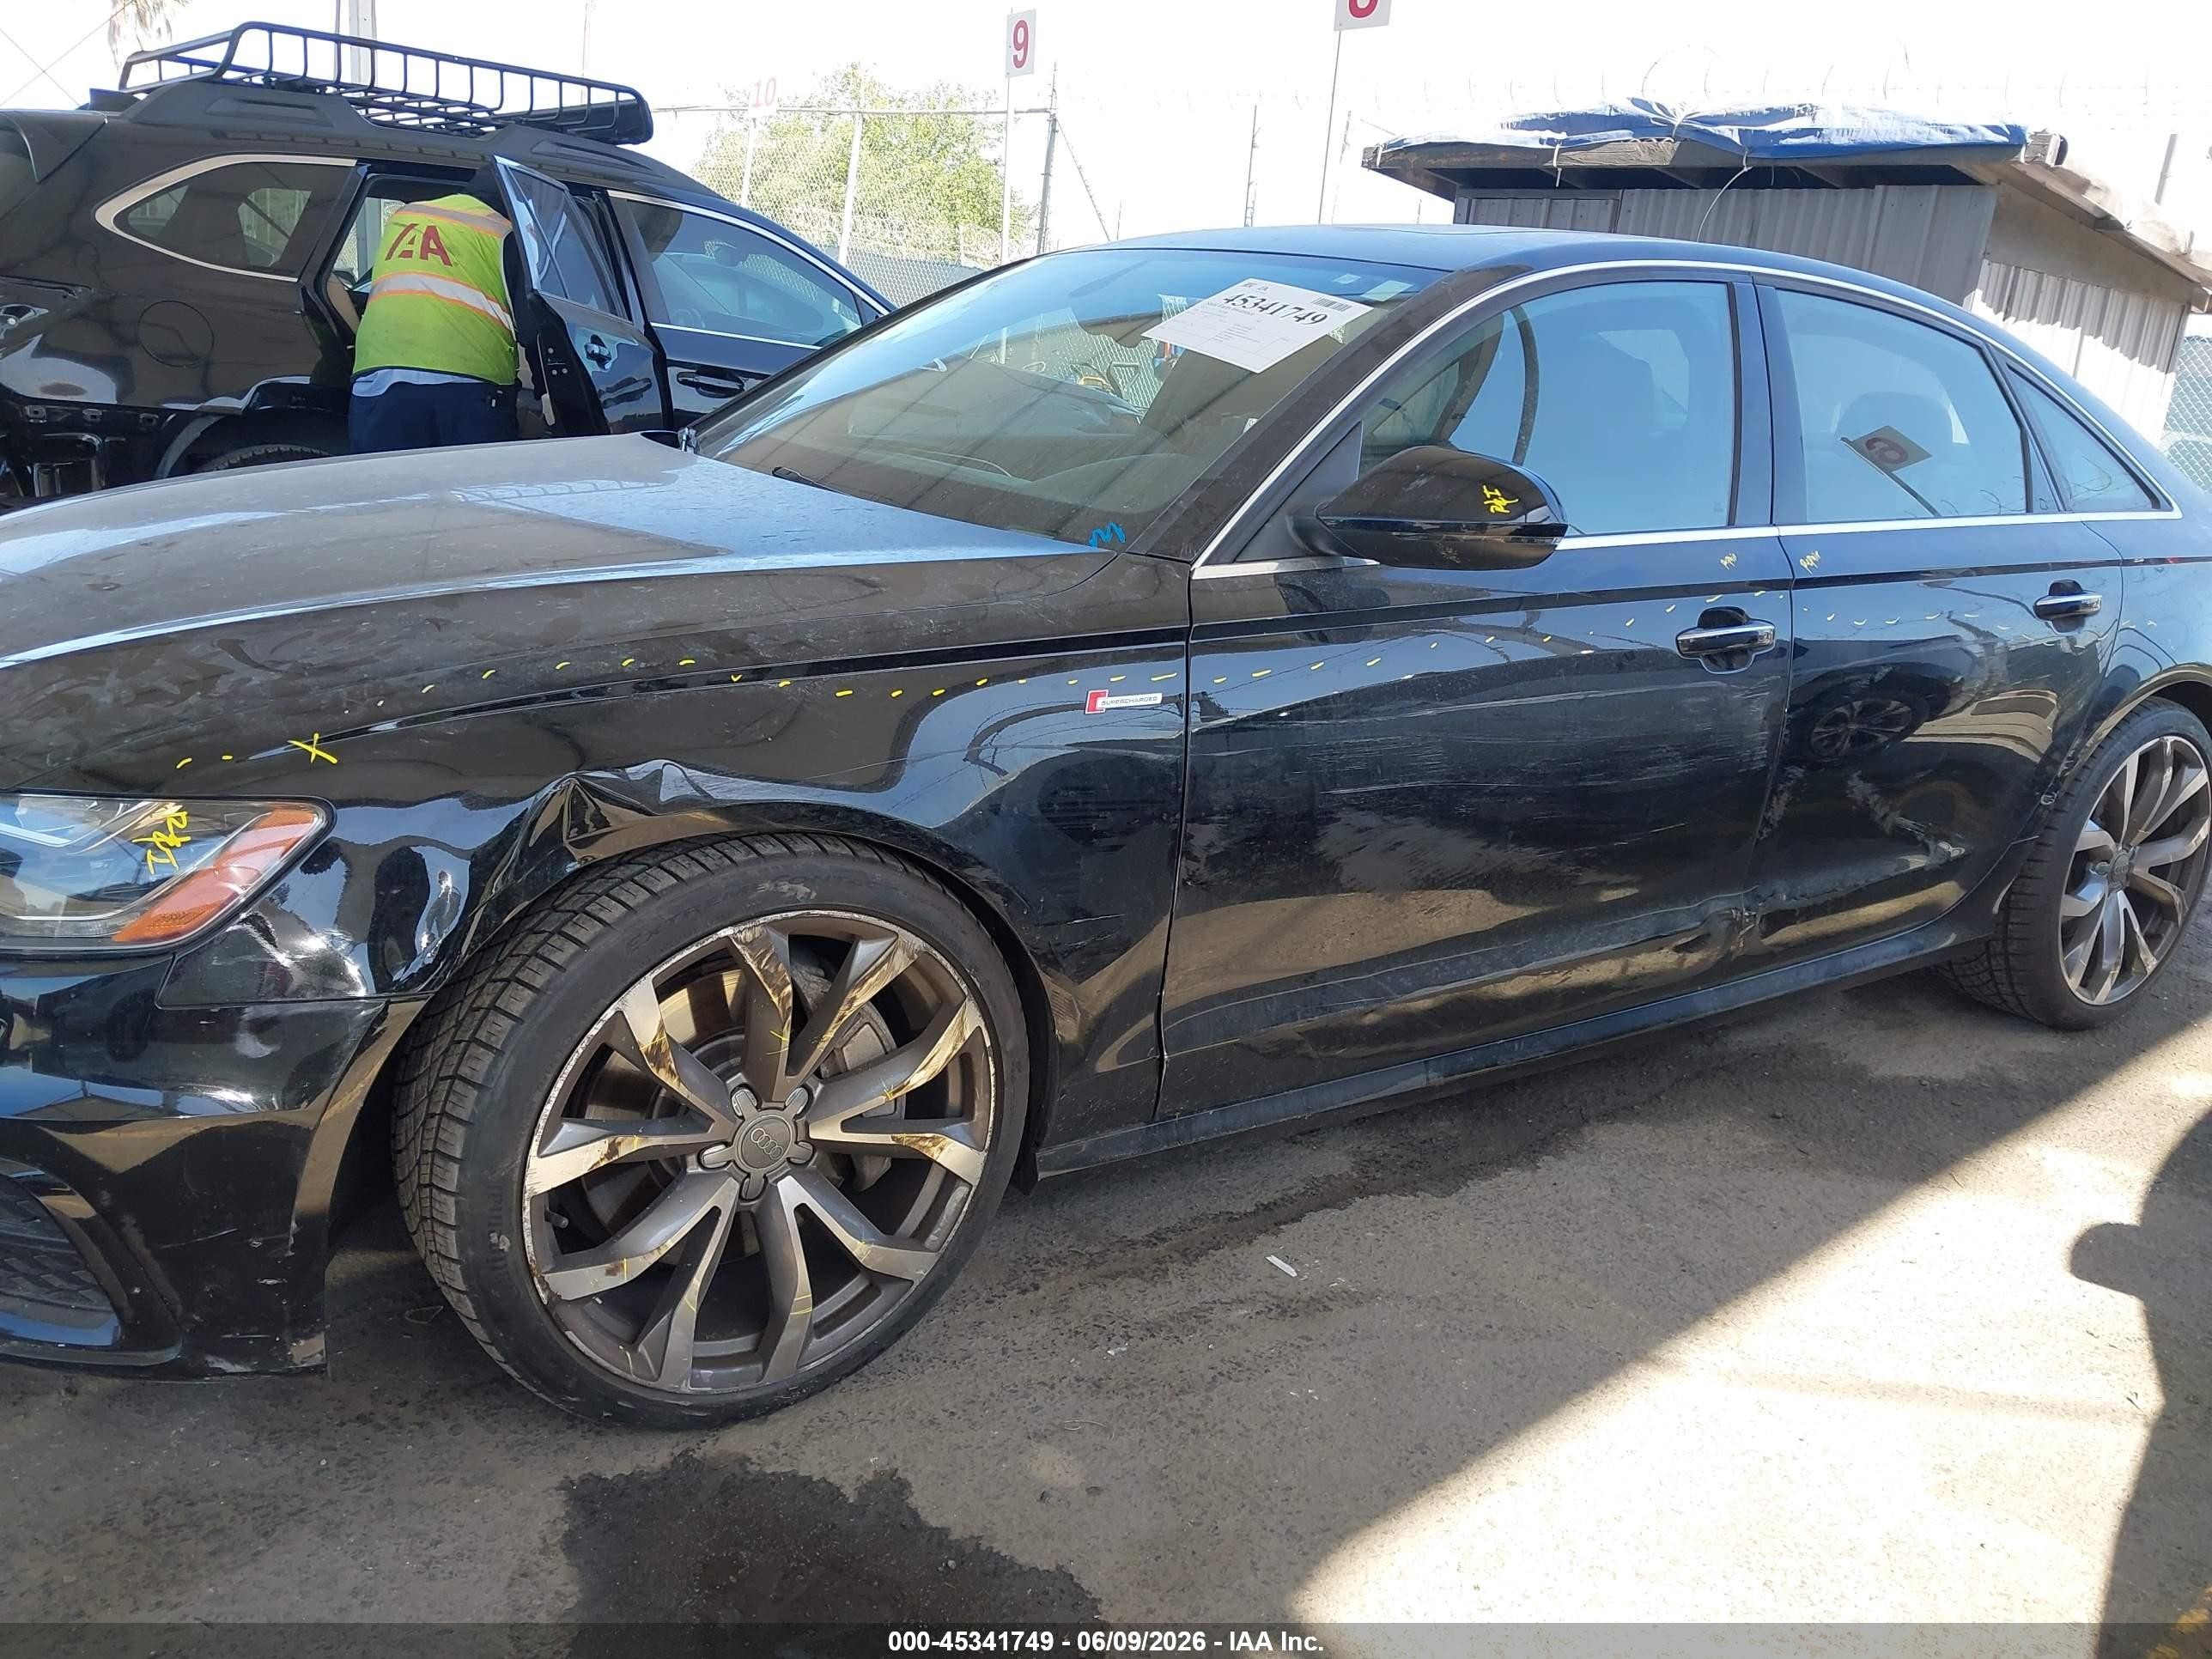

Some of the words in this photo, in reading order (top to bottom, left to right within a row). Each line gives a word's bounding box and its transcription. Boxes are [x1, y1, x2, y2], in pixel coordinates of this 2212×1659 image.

[1012, 19, 1029, 69] 9
[750, 76, 777, 108] 10
[1222, 293, 1329, 326] 45341749
